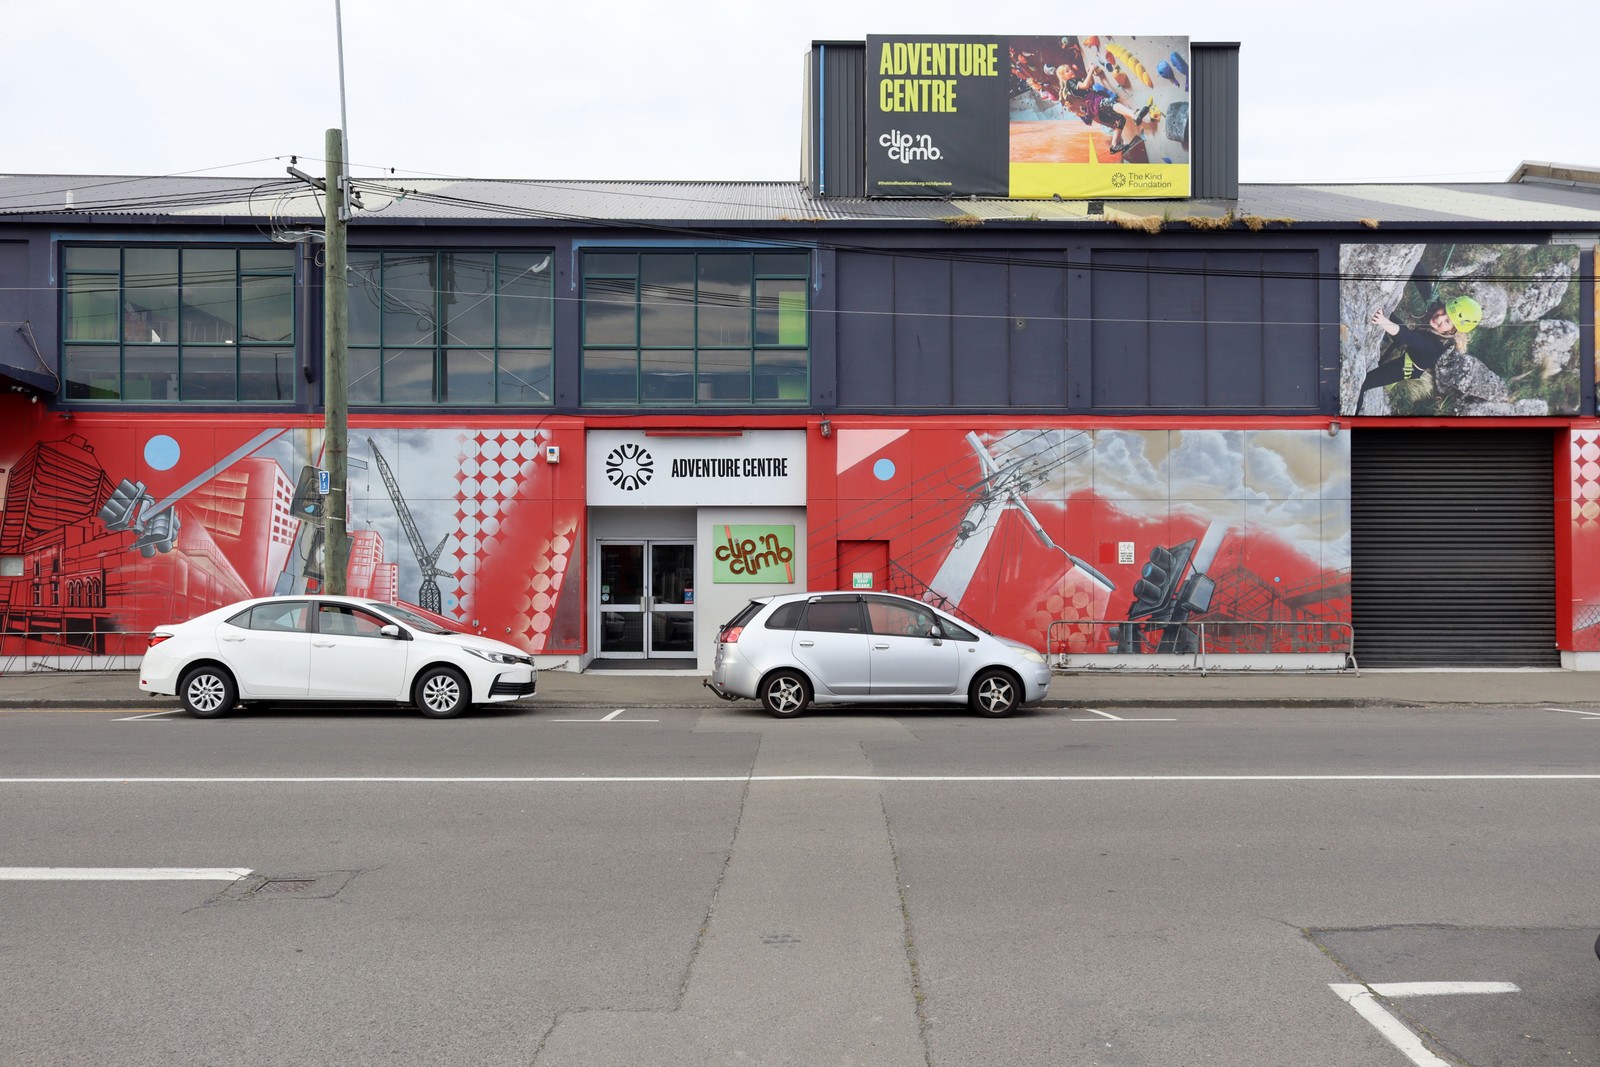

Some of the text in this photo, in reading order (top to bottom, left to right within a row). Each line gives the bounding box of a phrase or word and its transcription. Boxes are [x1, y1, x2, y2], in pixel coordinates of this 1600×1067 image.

[879, 43, 998, 76] ADVENTURE
[880, 79, 957, 112] CENTRE
[879, 129, 913, 149] clip
[1128, 172, 1163, 180] The Kind
[671, 458, 788, 478] ADVENTURE CENTRE
[715, 538, 757, 563] clip
[729, 547, 793, 575] climb
